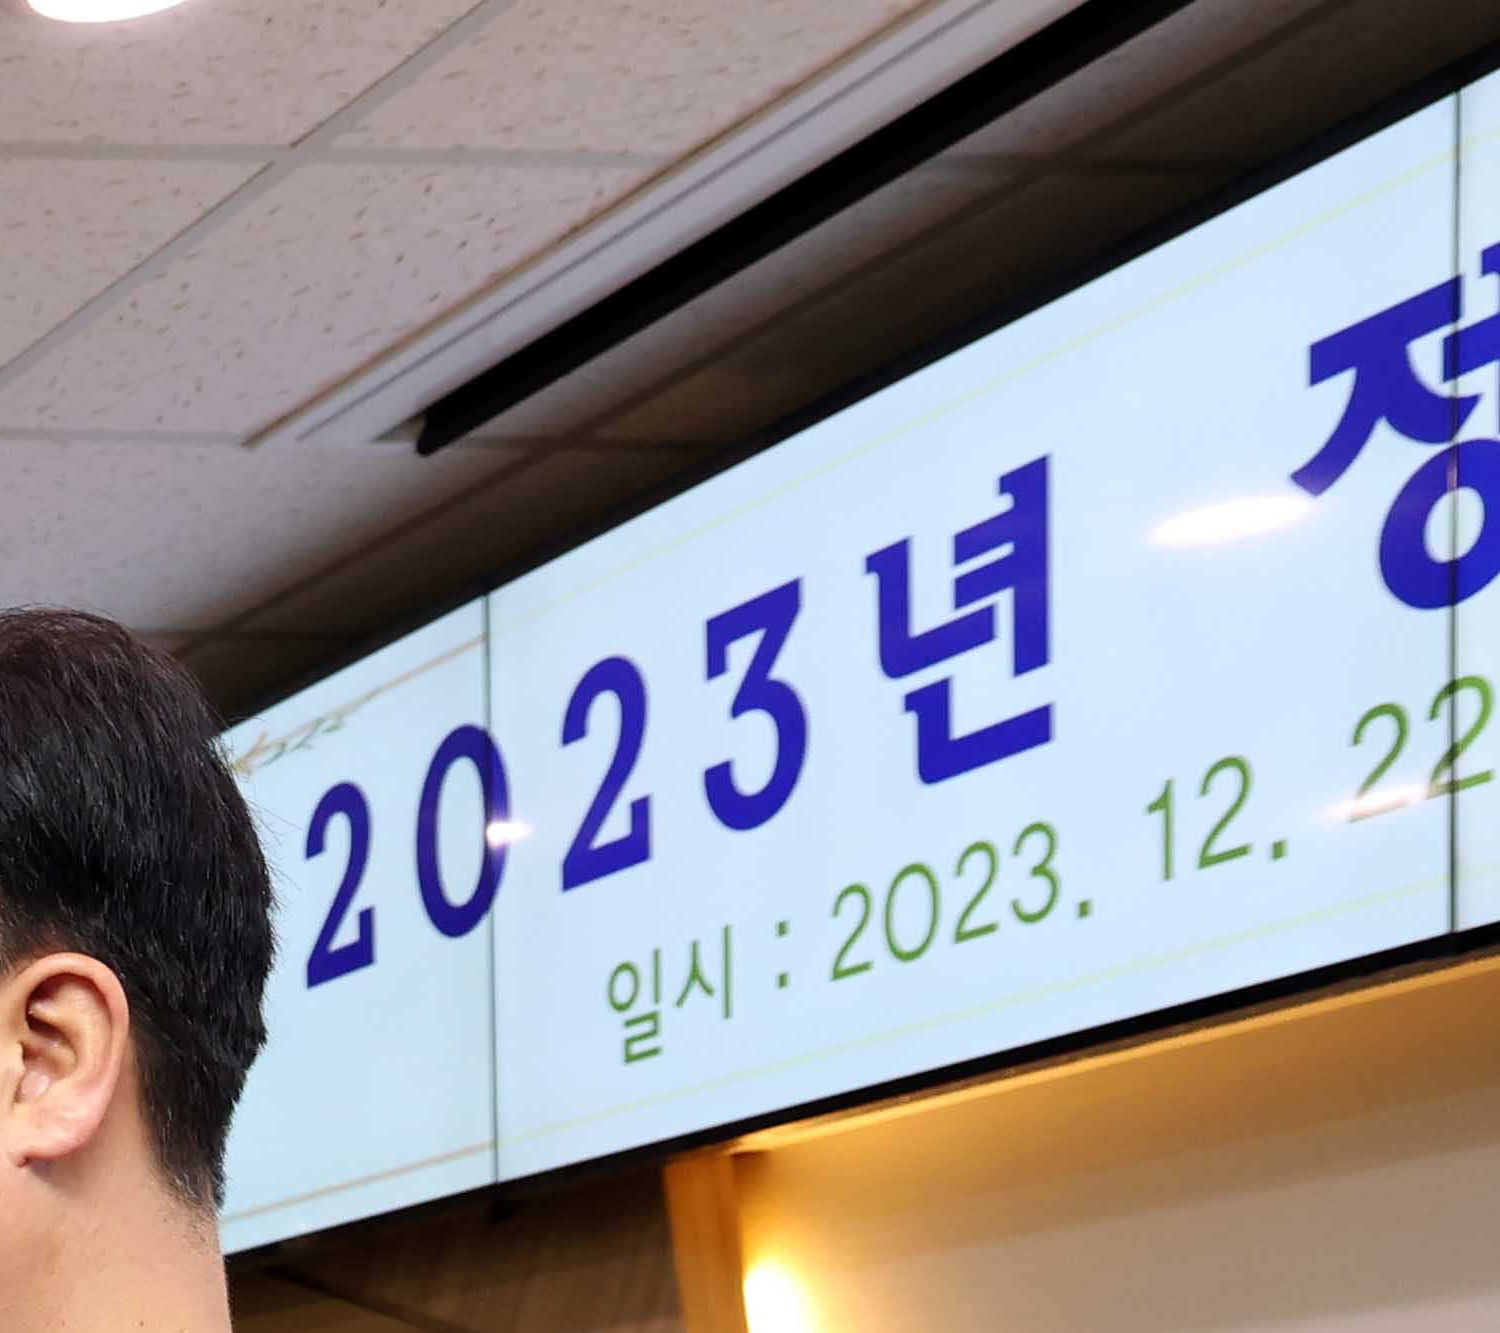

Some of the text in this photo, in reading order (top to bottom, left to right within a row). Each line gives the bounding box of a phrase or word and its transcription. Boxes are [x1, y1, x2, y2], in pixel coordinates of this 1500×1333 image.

[303, 453, 1055, 990] 2023년
[606, 923, 734, 1064] 일시
[829, 820, 1093, 982] 2023.
[1144, 755, 1289, 883] 12.
